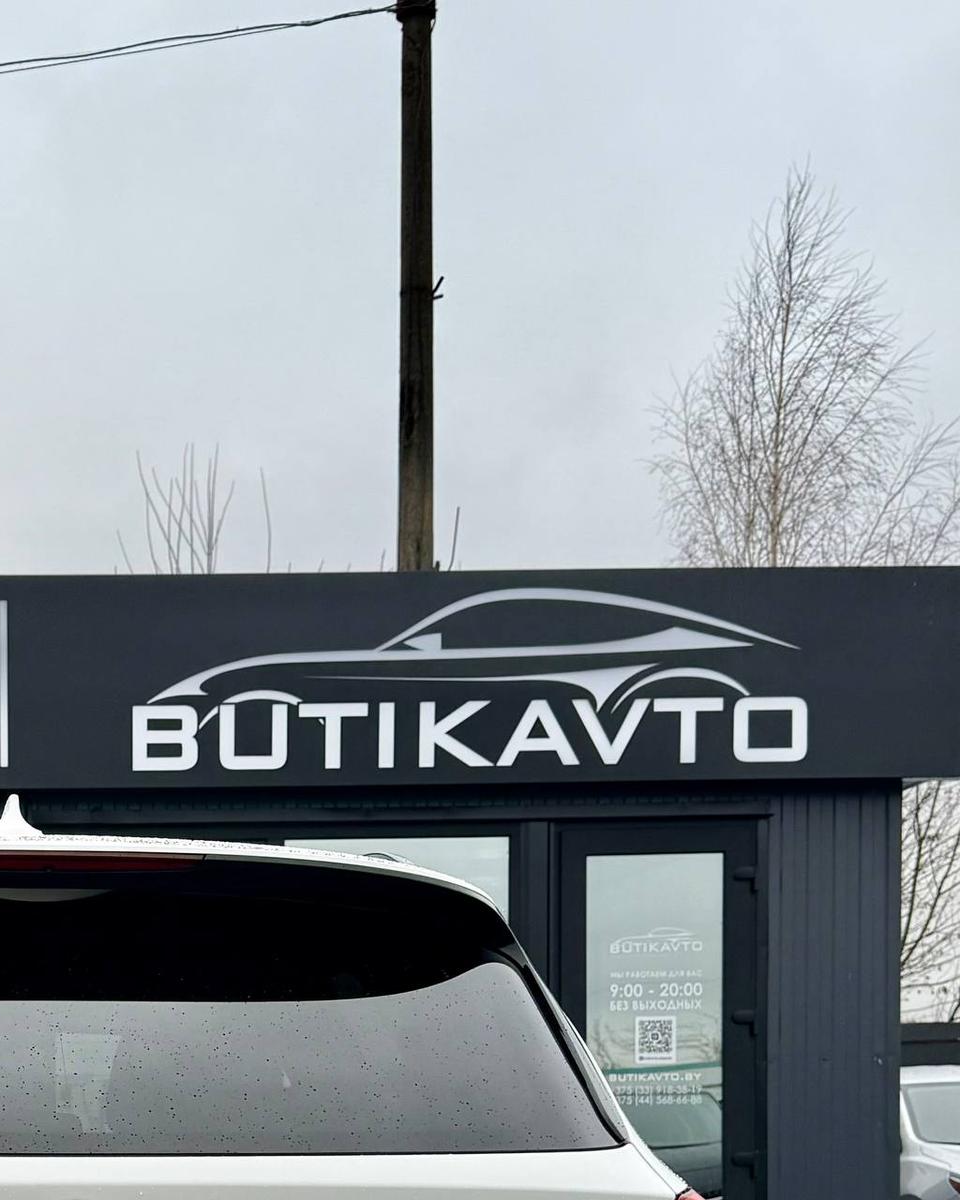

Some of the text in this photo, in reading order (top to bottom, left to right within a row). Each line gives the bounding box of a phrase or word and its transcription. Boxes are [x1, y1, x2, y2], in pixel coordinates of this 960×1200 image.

[131, 694, 809, 773] BUTIKAVTO
[609, 941, 703, 954] BUTIKAVTO
[610, 983, 643, 998] 9:00
[659, 982, 703, 997] 20:00
[609, 999, 702, 1012] БЕЗ ВЫХОДНЫХ
[609, 1073, 702, 1082] BUTIKAVTO.BY
